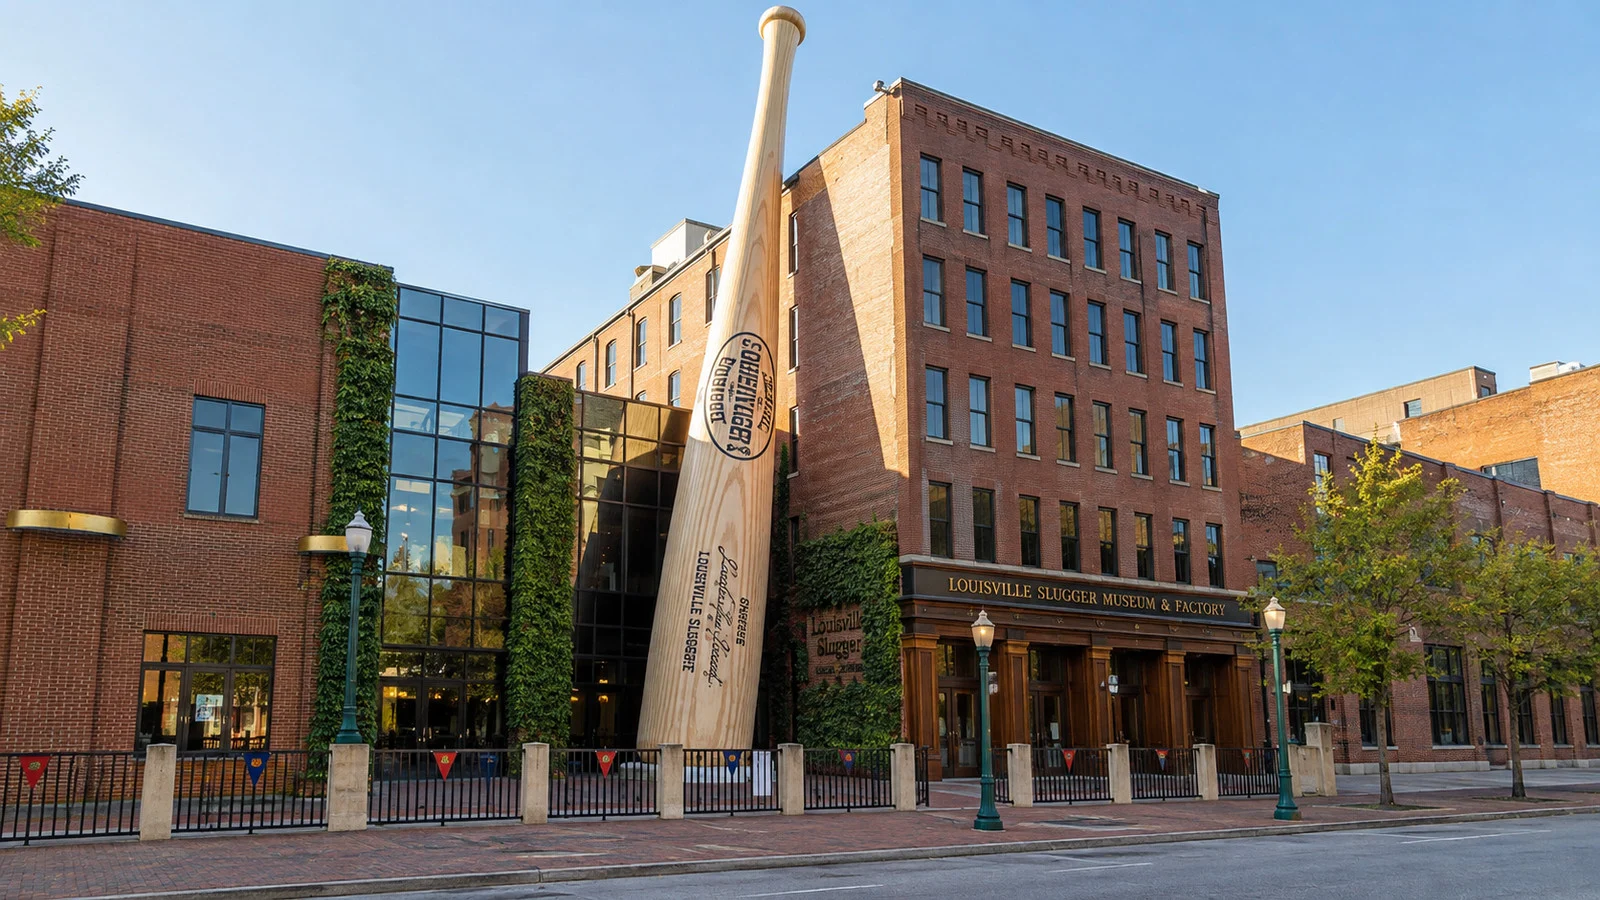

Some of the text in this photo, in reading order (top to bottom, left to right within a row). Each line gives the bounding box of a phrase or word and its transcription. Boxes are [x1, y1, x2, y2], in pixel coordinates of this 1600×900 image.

[949, 577, 1226, 616] LOUISVILLE SLUGGER MUSEUM & FACTORY
[816, 637, 861, 660] Slugger
